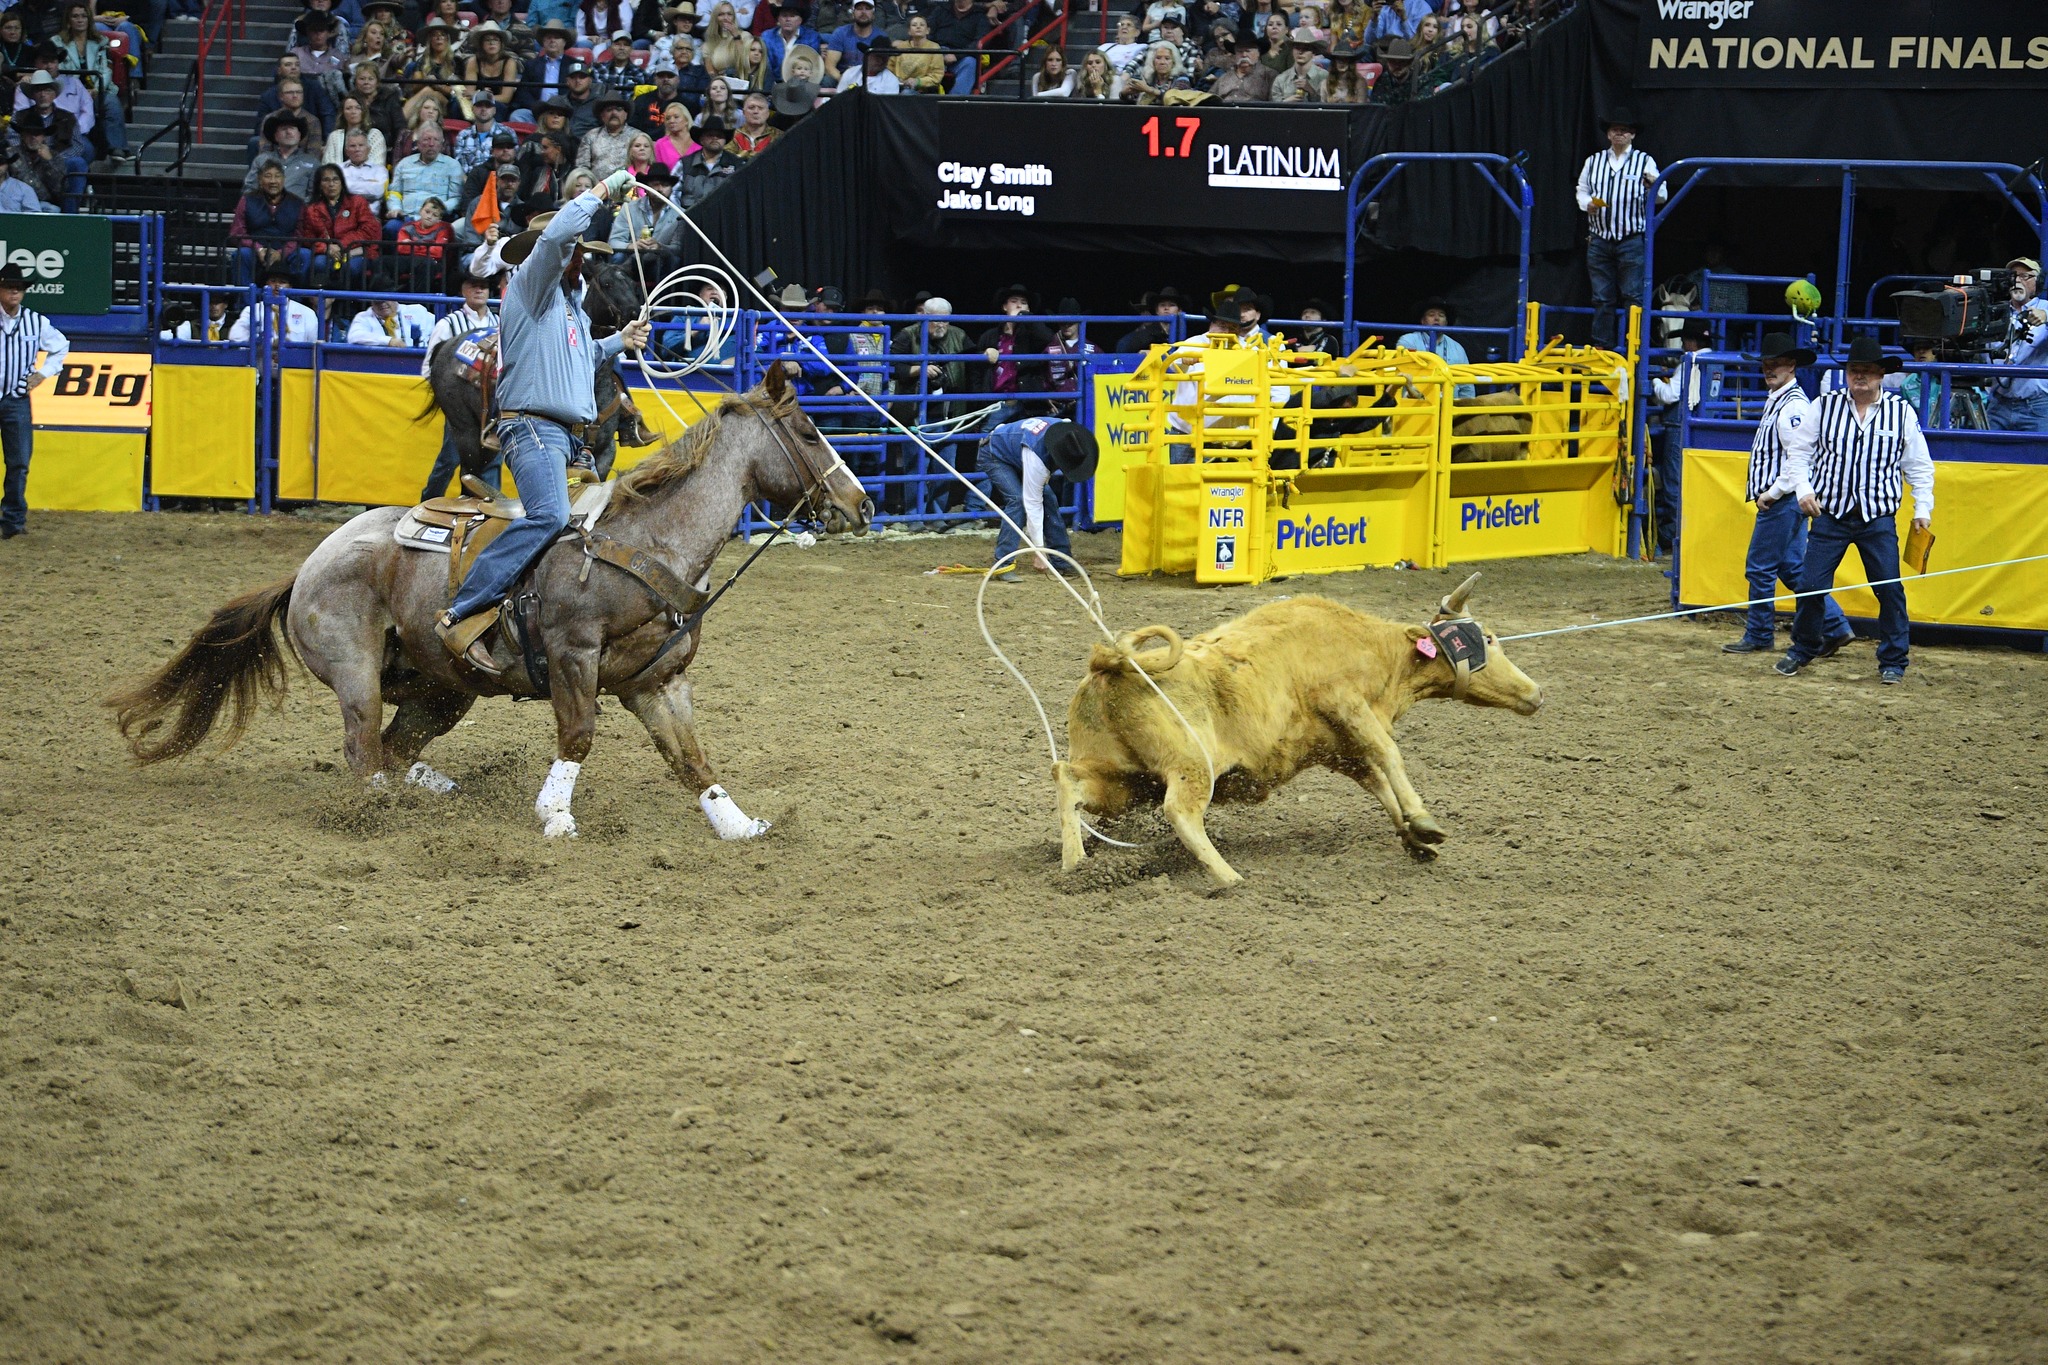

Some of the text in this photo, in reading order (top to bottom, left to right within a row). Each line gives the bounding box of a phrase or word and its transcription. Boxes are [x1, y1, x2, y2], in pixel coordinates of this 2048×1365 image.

[1658, 0, 1754, 30] Wrangler
[1649, 37, 2048, 69] NATIONAL FINALS
[1141, 116, 1201, 158] 1.7
[937, 161, 1053, 189] Clay Smith
[1207, 143, 1341, 178] PLATINUM
[936, 189, 1035, 216] Jake Long
[53, 363, 149, 406] Big
[1210, 486, 1245, 502] Wrangler
[1208, 507, 1245, 528] NFR
[1461, 495, 1540, 531] Priefert
[1276, 512, 1367, 550] Priefert
